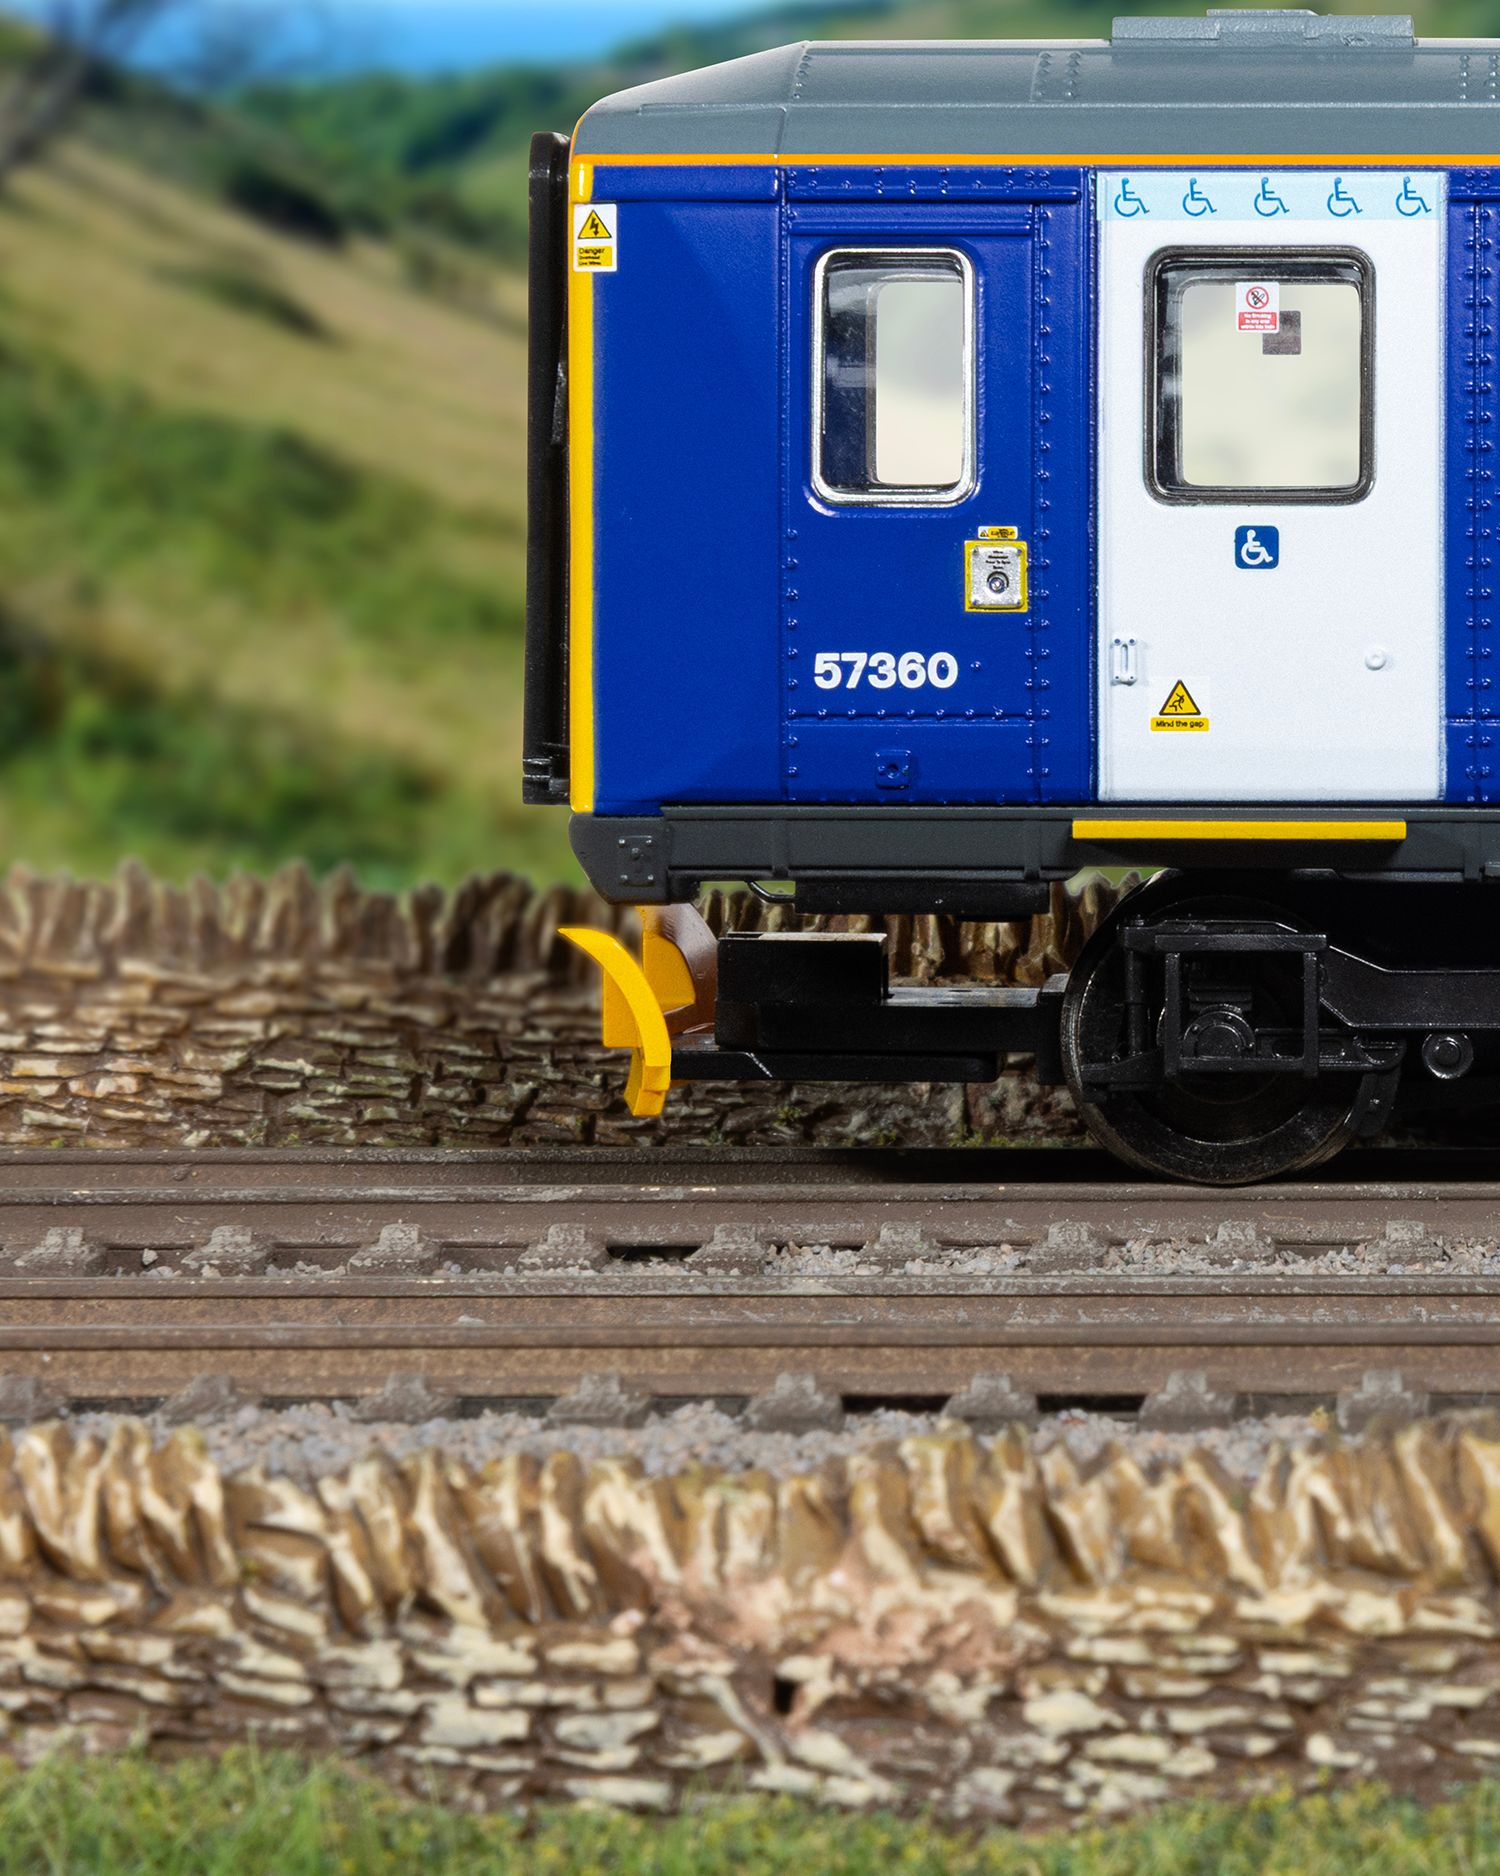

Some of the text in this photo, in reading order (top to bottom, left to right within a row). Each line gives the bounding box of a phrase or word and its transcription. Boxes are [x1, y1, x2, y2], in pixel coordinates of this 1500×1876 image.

[578, 247, 605, 255] Danger
[813, 651, 959, 690] 57360
[1155, 720, 1205, 729] Mind the gap
